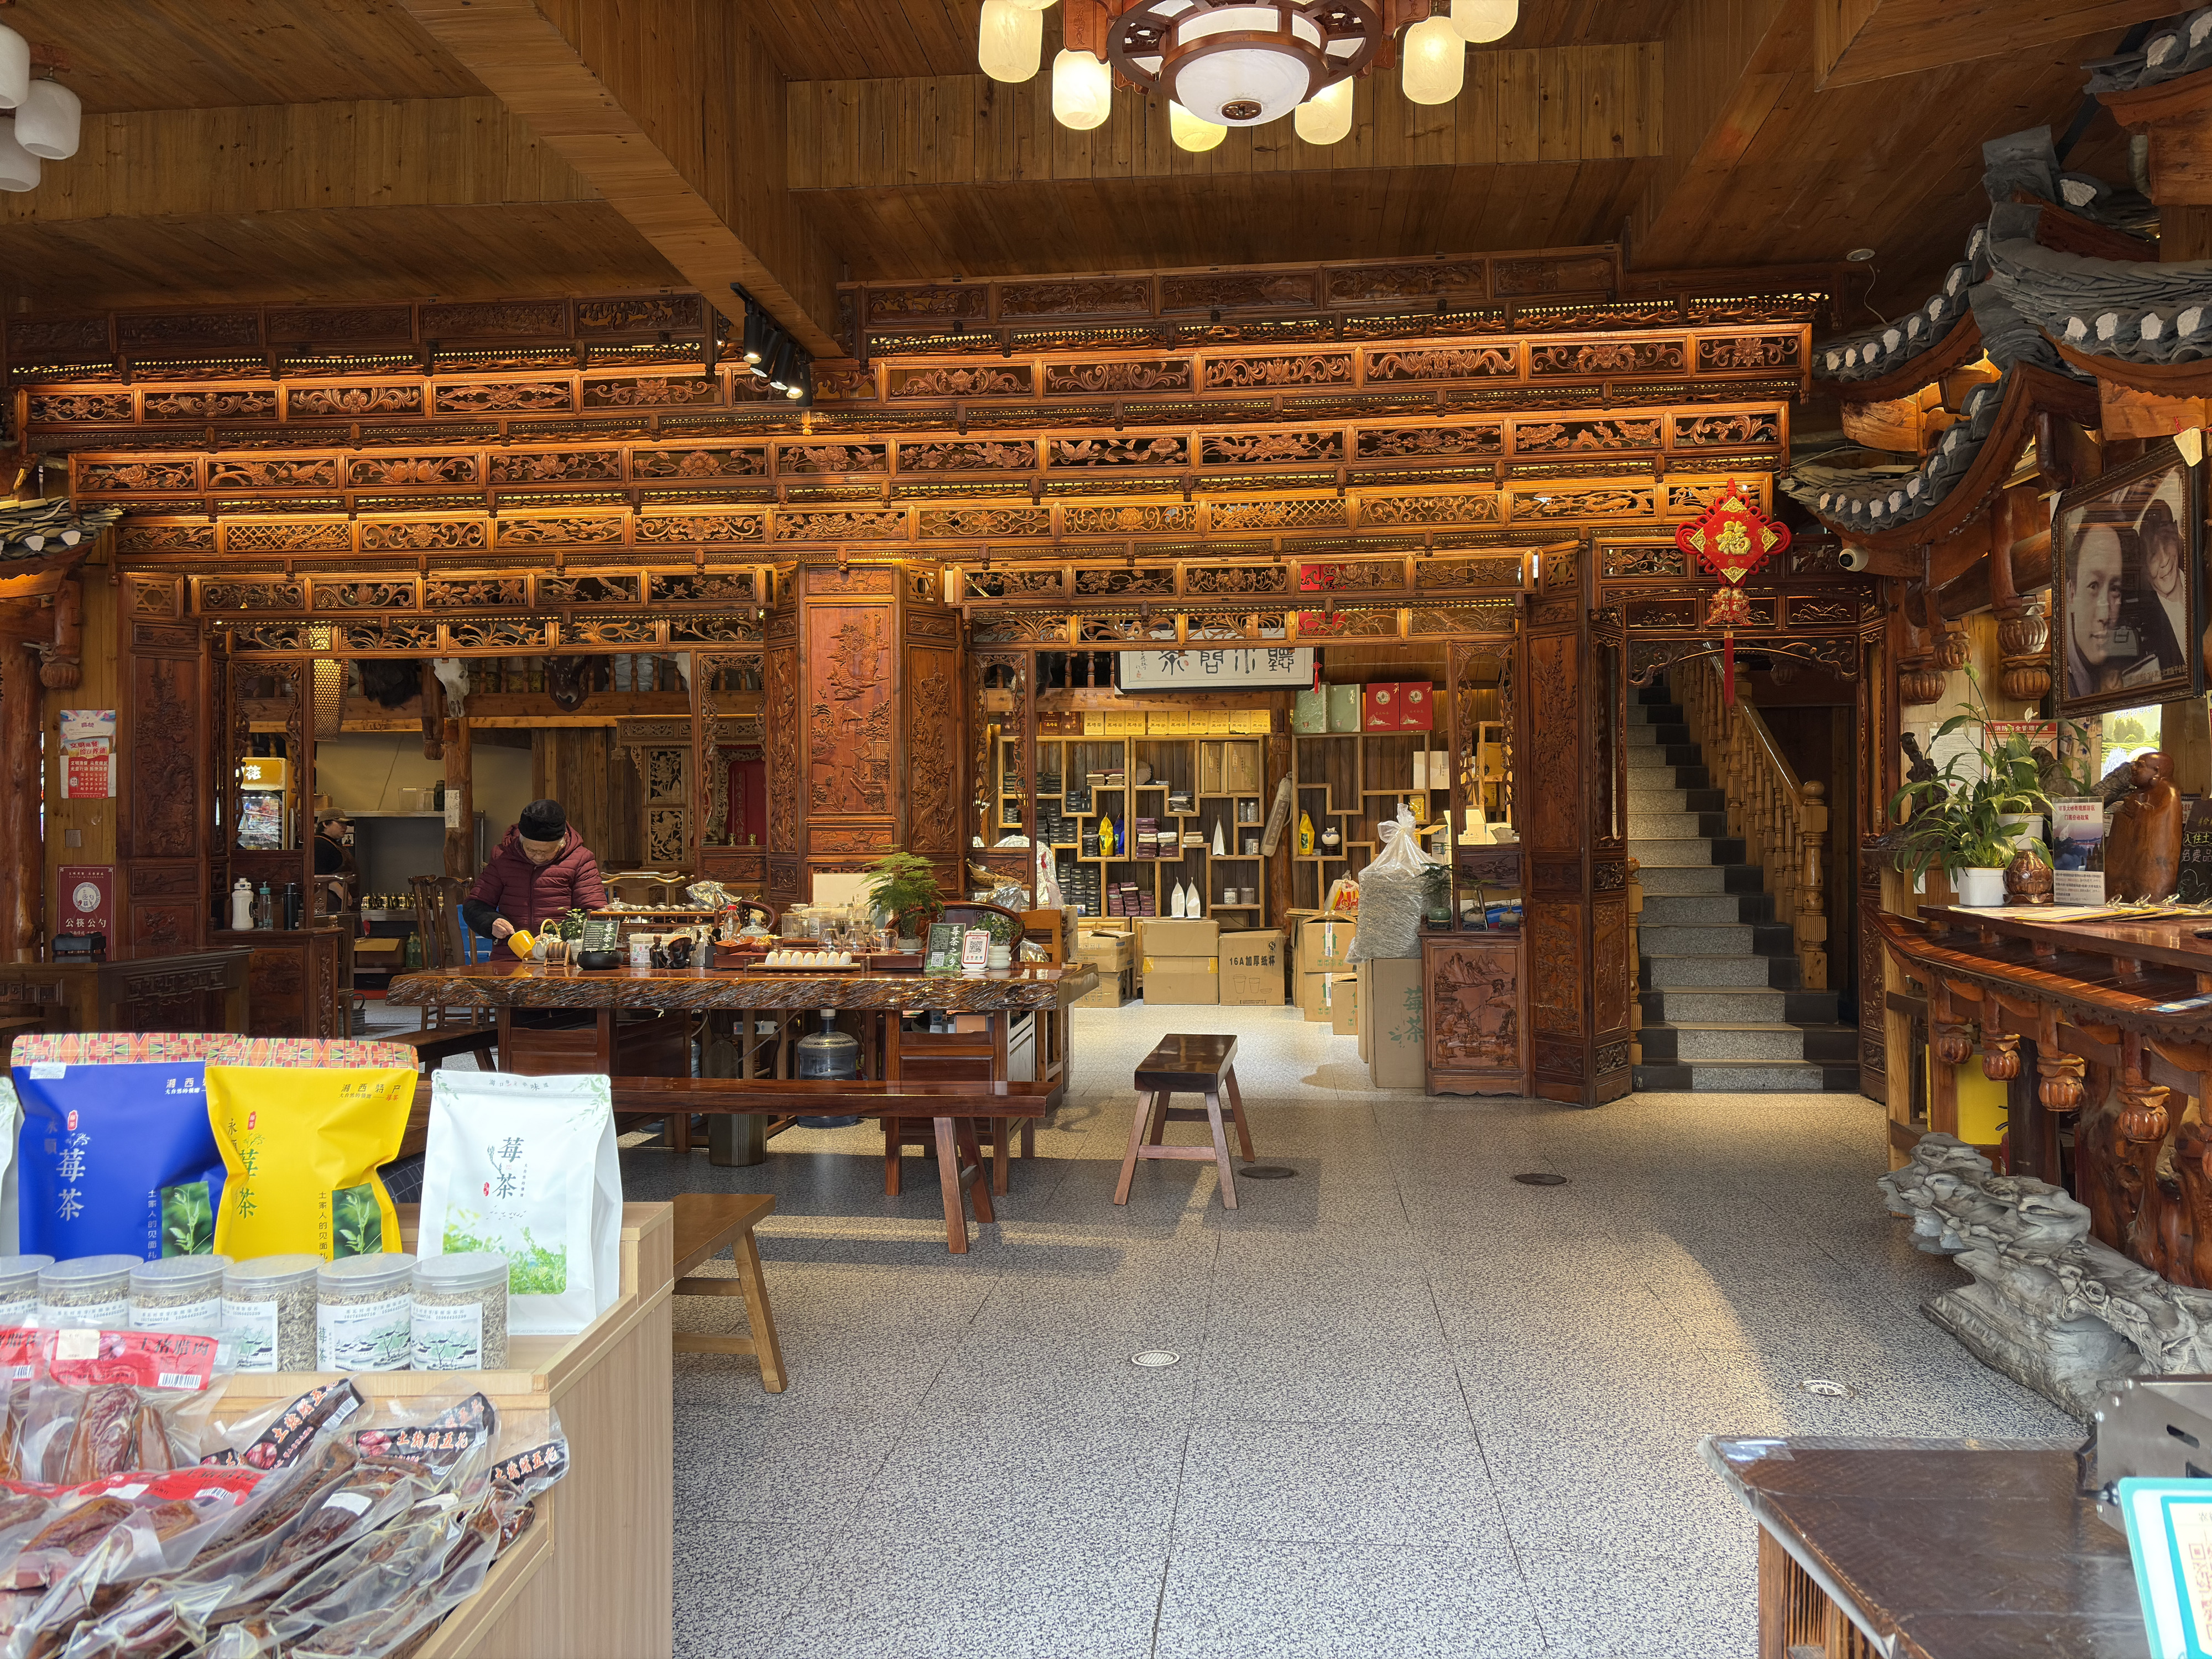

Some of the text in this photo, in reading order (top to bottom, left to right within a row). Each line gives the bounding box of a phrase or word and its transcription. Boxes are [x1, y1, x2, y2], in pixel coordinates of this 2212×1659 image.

[1716, 521, 1751, 555] 福
[2184, 833, 2212, 845] 入住土
[65, 918, 107, 927] 公筷公勺
[948, 925, 961, 967] 莓茶之乡
[1229, 955, 1275, 966] 16A加厚纸杯
[1402, 985, 1423, 1044] 莓茶
[341, 1083, 401, 1093] 湘西特产
[55, 1147, 86, 1222] 莓茶
[492, 1137, 524, 1199] 莓茶
[147, 1190, 157, 1259] 土家人的见面礼
[318, 1191, 328, 1260] 土家人的见面礼
[141, 1336, 210, 1357] 土猪腊肉
